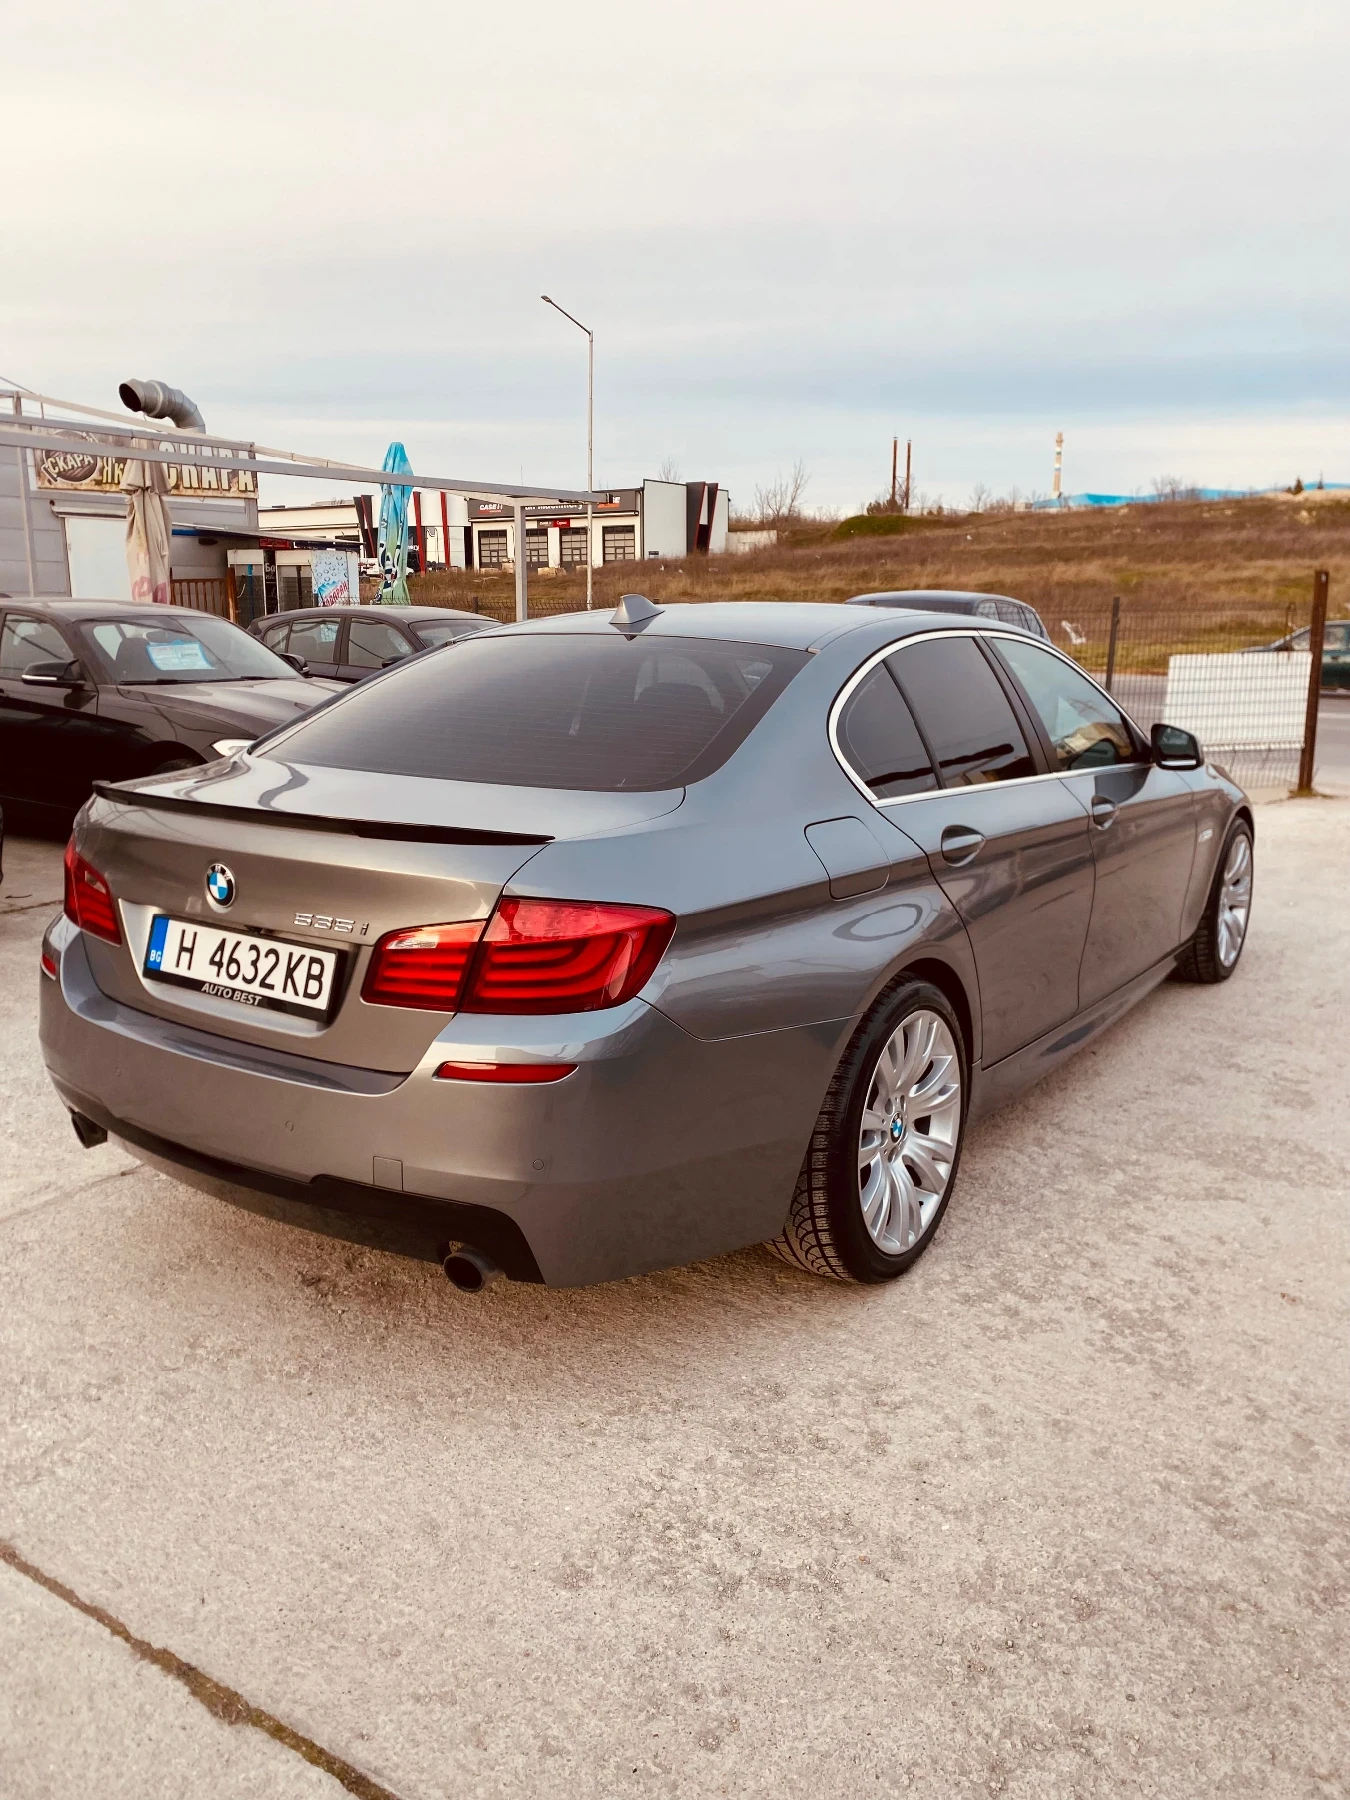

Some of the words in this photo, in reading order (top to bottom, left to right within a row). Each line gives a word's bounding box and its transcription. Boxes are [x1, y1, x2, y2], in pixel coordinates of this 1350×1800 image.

[48, 453, 94, 474] СКАРА
[149, 949, 162, 963] BG
[174, 928, 198, 971] H
[201, 982, 232, 999] AUTO
[232, 991, 262, 1006] BEST
